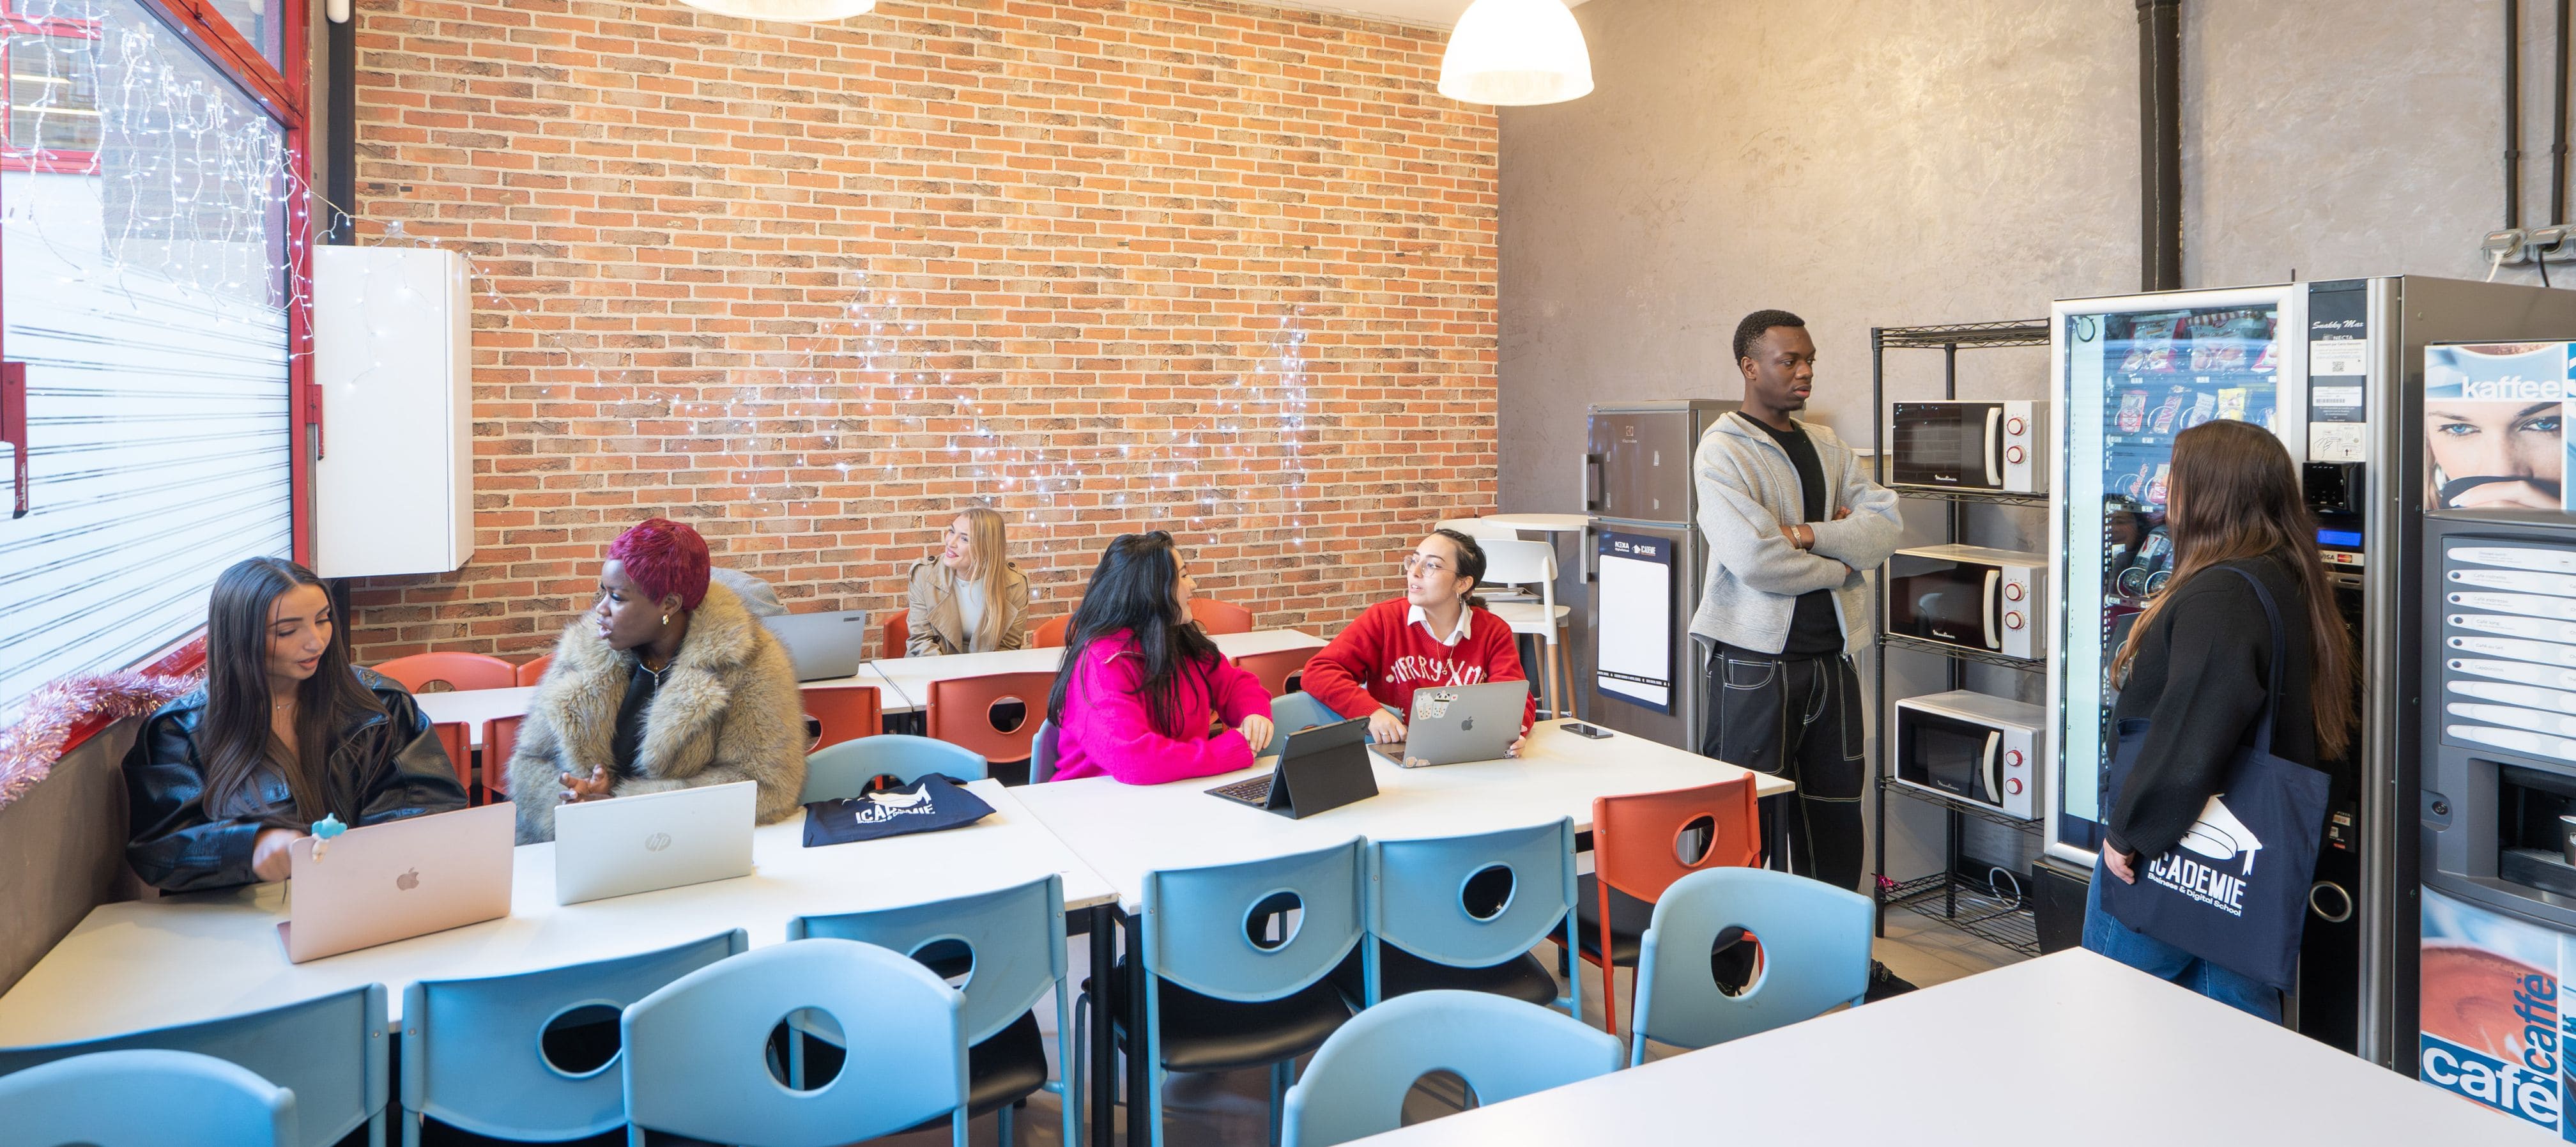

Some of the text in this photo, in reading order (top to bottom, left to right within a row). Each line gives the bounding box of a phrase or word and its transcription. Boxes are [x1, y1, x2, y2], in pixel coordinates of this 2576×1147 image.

[2462, 376, 2561, 399] kaffee
[1391, 655, 1442, 684] MERRY
[645, 832, 671, 852] hp
[2147, 872, 2179, 891] Business
[2186, 889, 2213, 905] Digital
[2214, 900, 2241, 917] School
[2423, 1048, 2558, 1123] café
